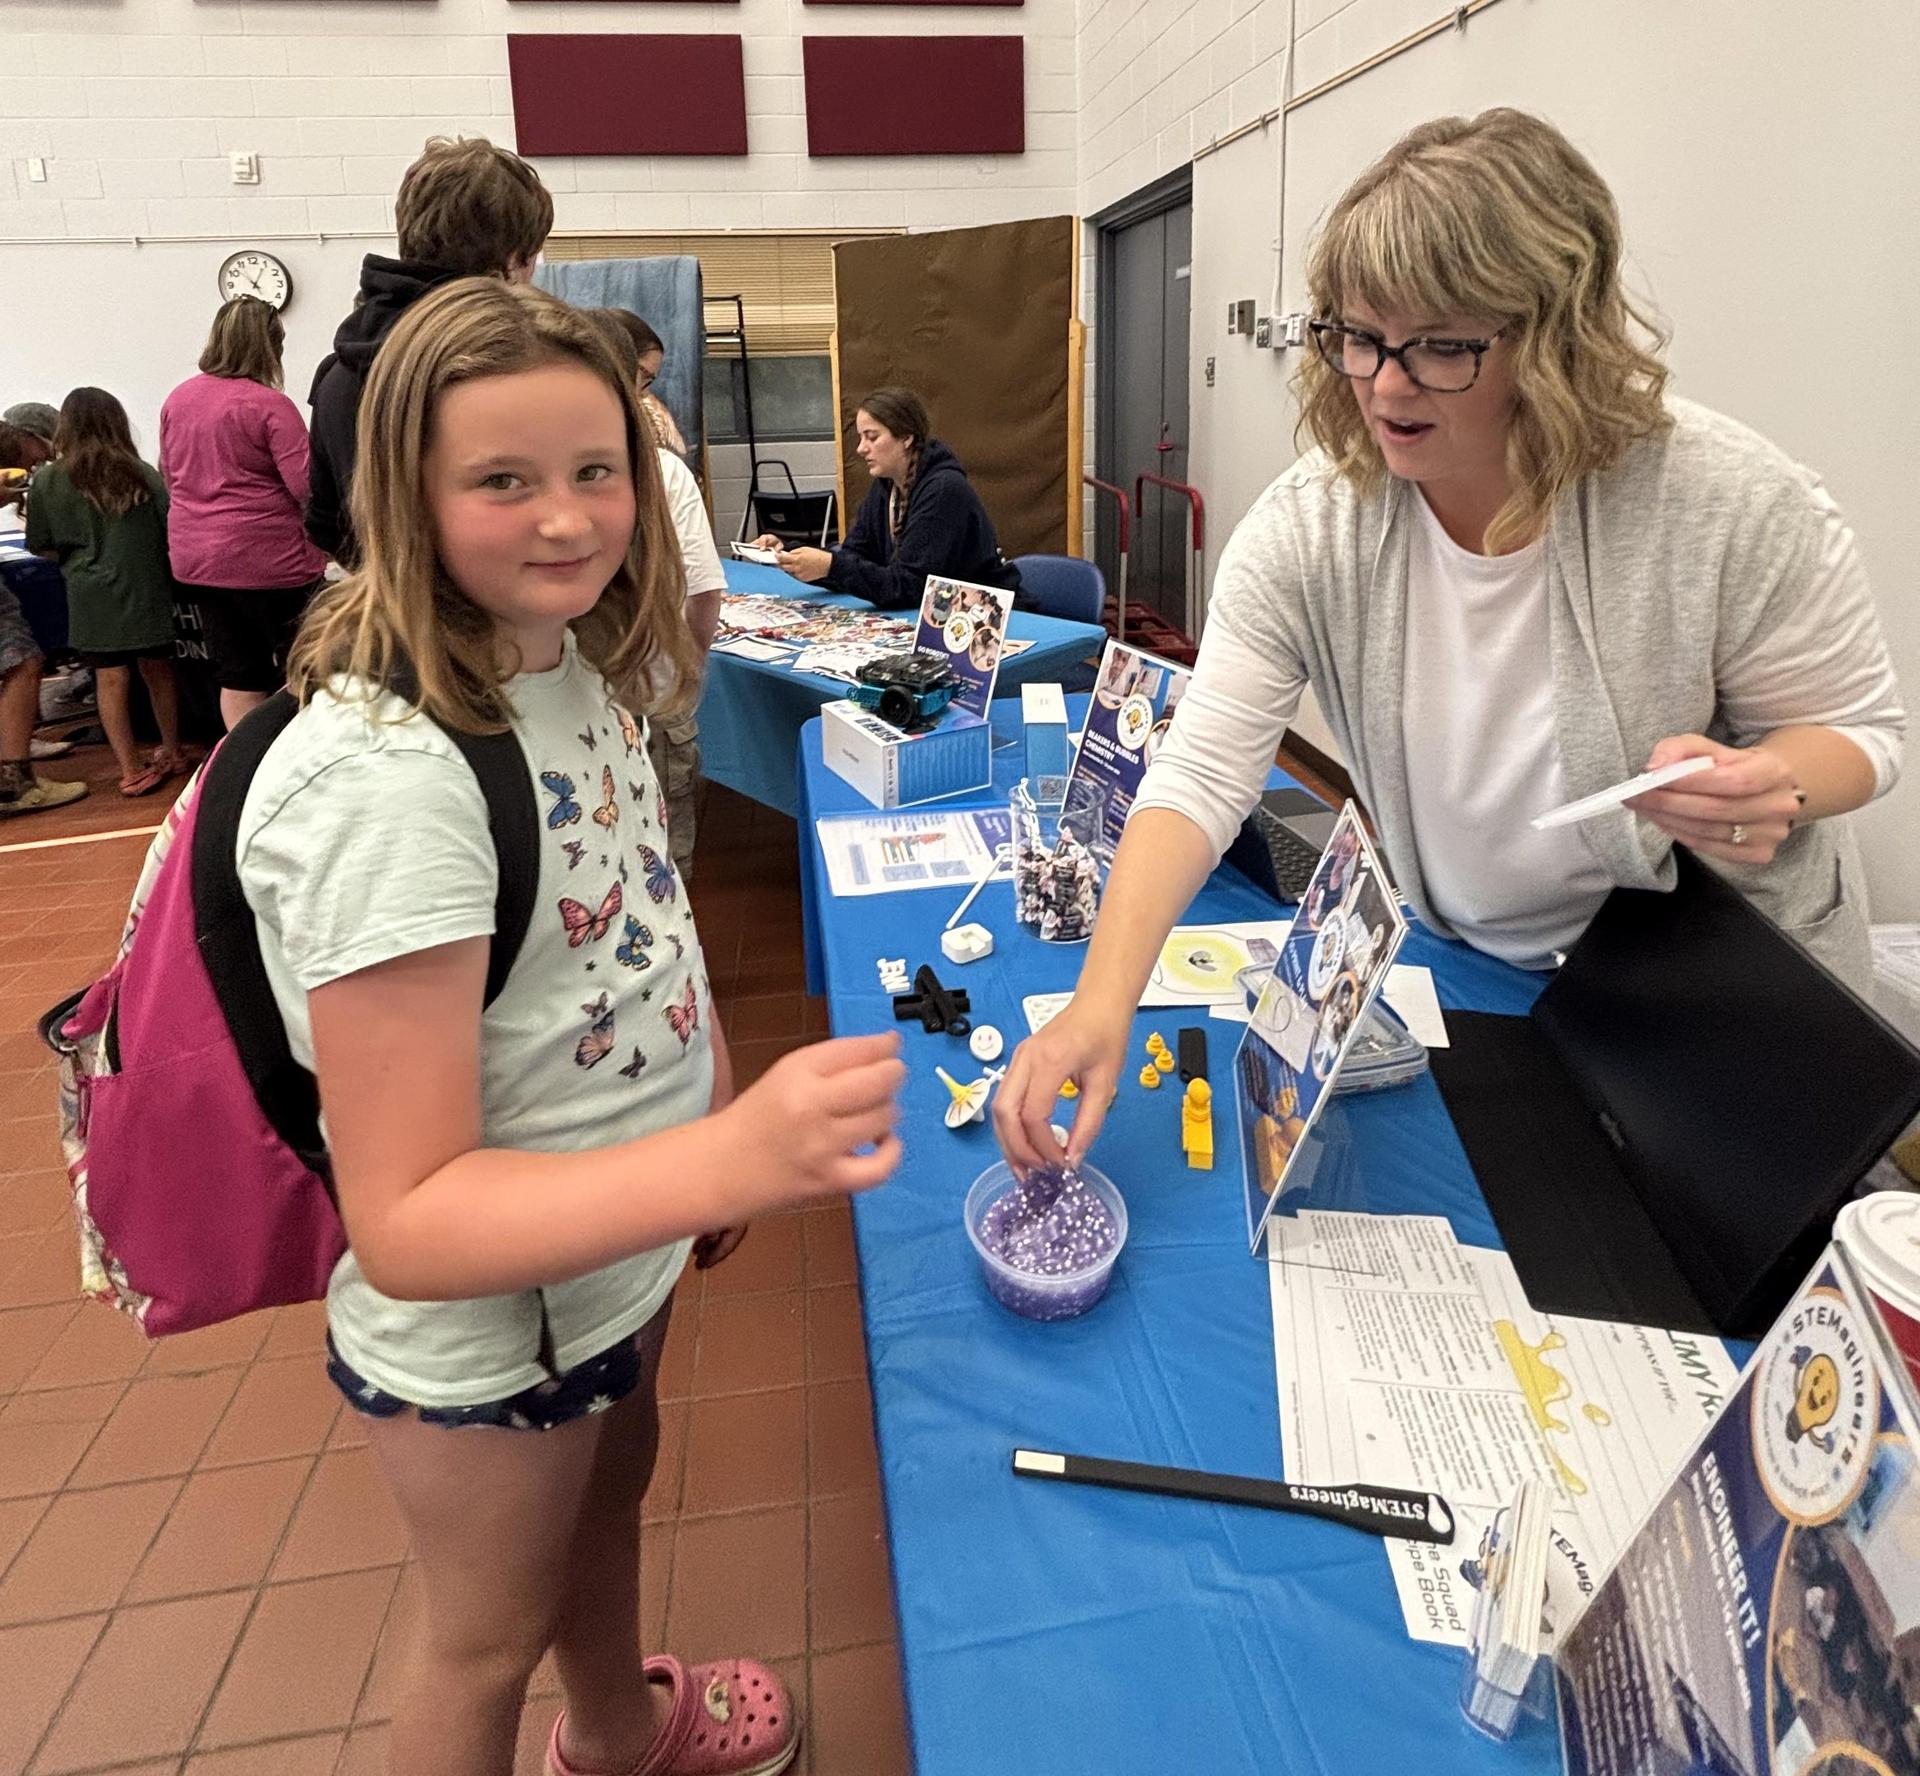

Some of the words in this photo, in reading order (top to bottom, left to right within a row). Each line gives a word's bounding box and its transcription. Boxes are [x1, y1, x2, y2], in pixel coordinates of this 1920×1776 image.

[247, 256, 259, 265] 12
[263, 260, 268, 268] 1
[228, 269, 240, 278] 10
[271, 269, 279, 277] 2
[277, 280, 284, 288] 3
[227, 281, 234, 289] 9
[172, 602, 203, 630] HI
[1085, 739, 1115, 761] CHEMISTRY
[1087, 729, 1111, 750] BEAKERS
[1791, 1305, 1865, 1465] STEMagineers
[1289, 1486, 1426, 1521] STEMagineers
[1550, 1527, 1594, 1597] TEMag
[1418, 1577, 1445, 1632] Book
[1433, 1566, 1466, 1632] Squad
[1739, 1596, 1762, 1649] IT!
